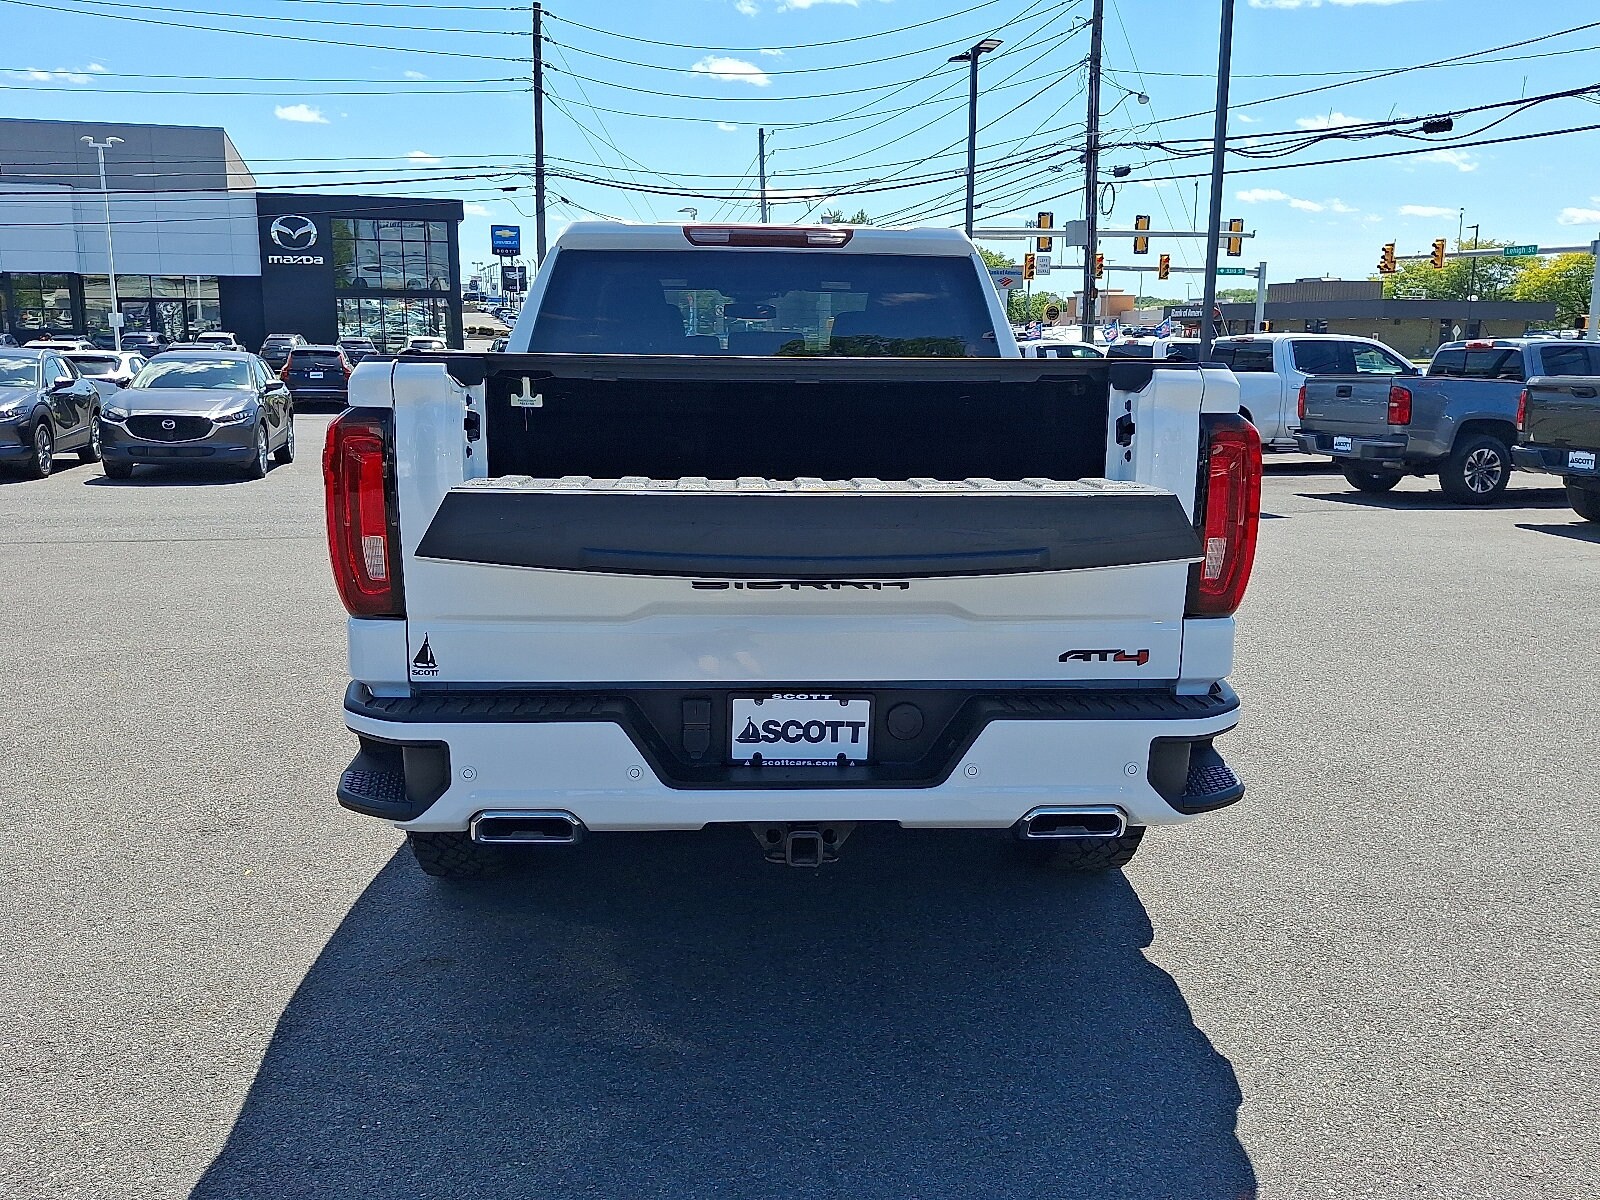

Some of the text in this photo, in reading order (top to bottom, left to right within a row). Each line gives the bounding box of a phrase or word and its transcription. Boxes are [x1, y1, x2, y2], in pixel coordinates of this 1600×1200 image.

[1506, 246, 1526, 255] Lehigh
[268, 255, 324, 265] mazda
[1187, 308, 1203, 317] Ameri
[1058, 648, 1150, 667] AT4
[411, 669, 440, 677] SCOTT
[761, 719, 866, 744] SCOTT
[761, 759, 838, 767] scottcars.com
